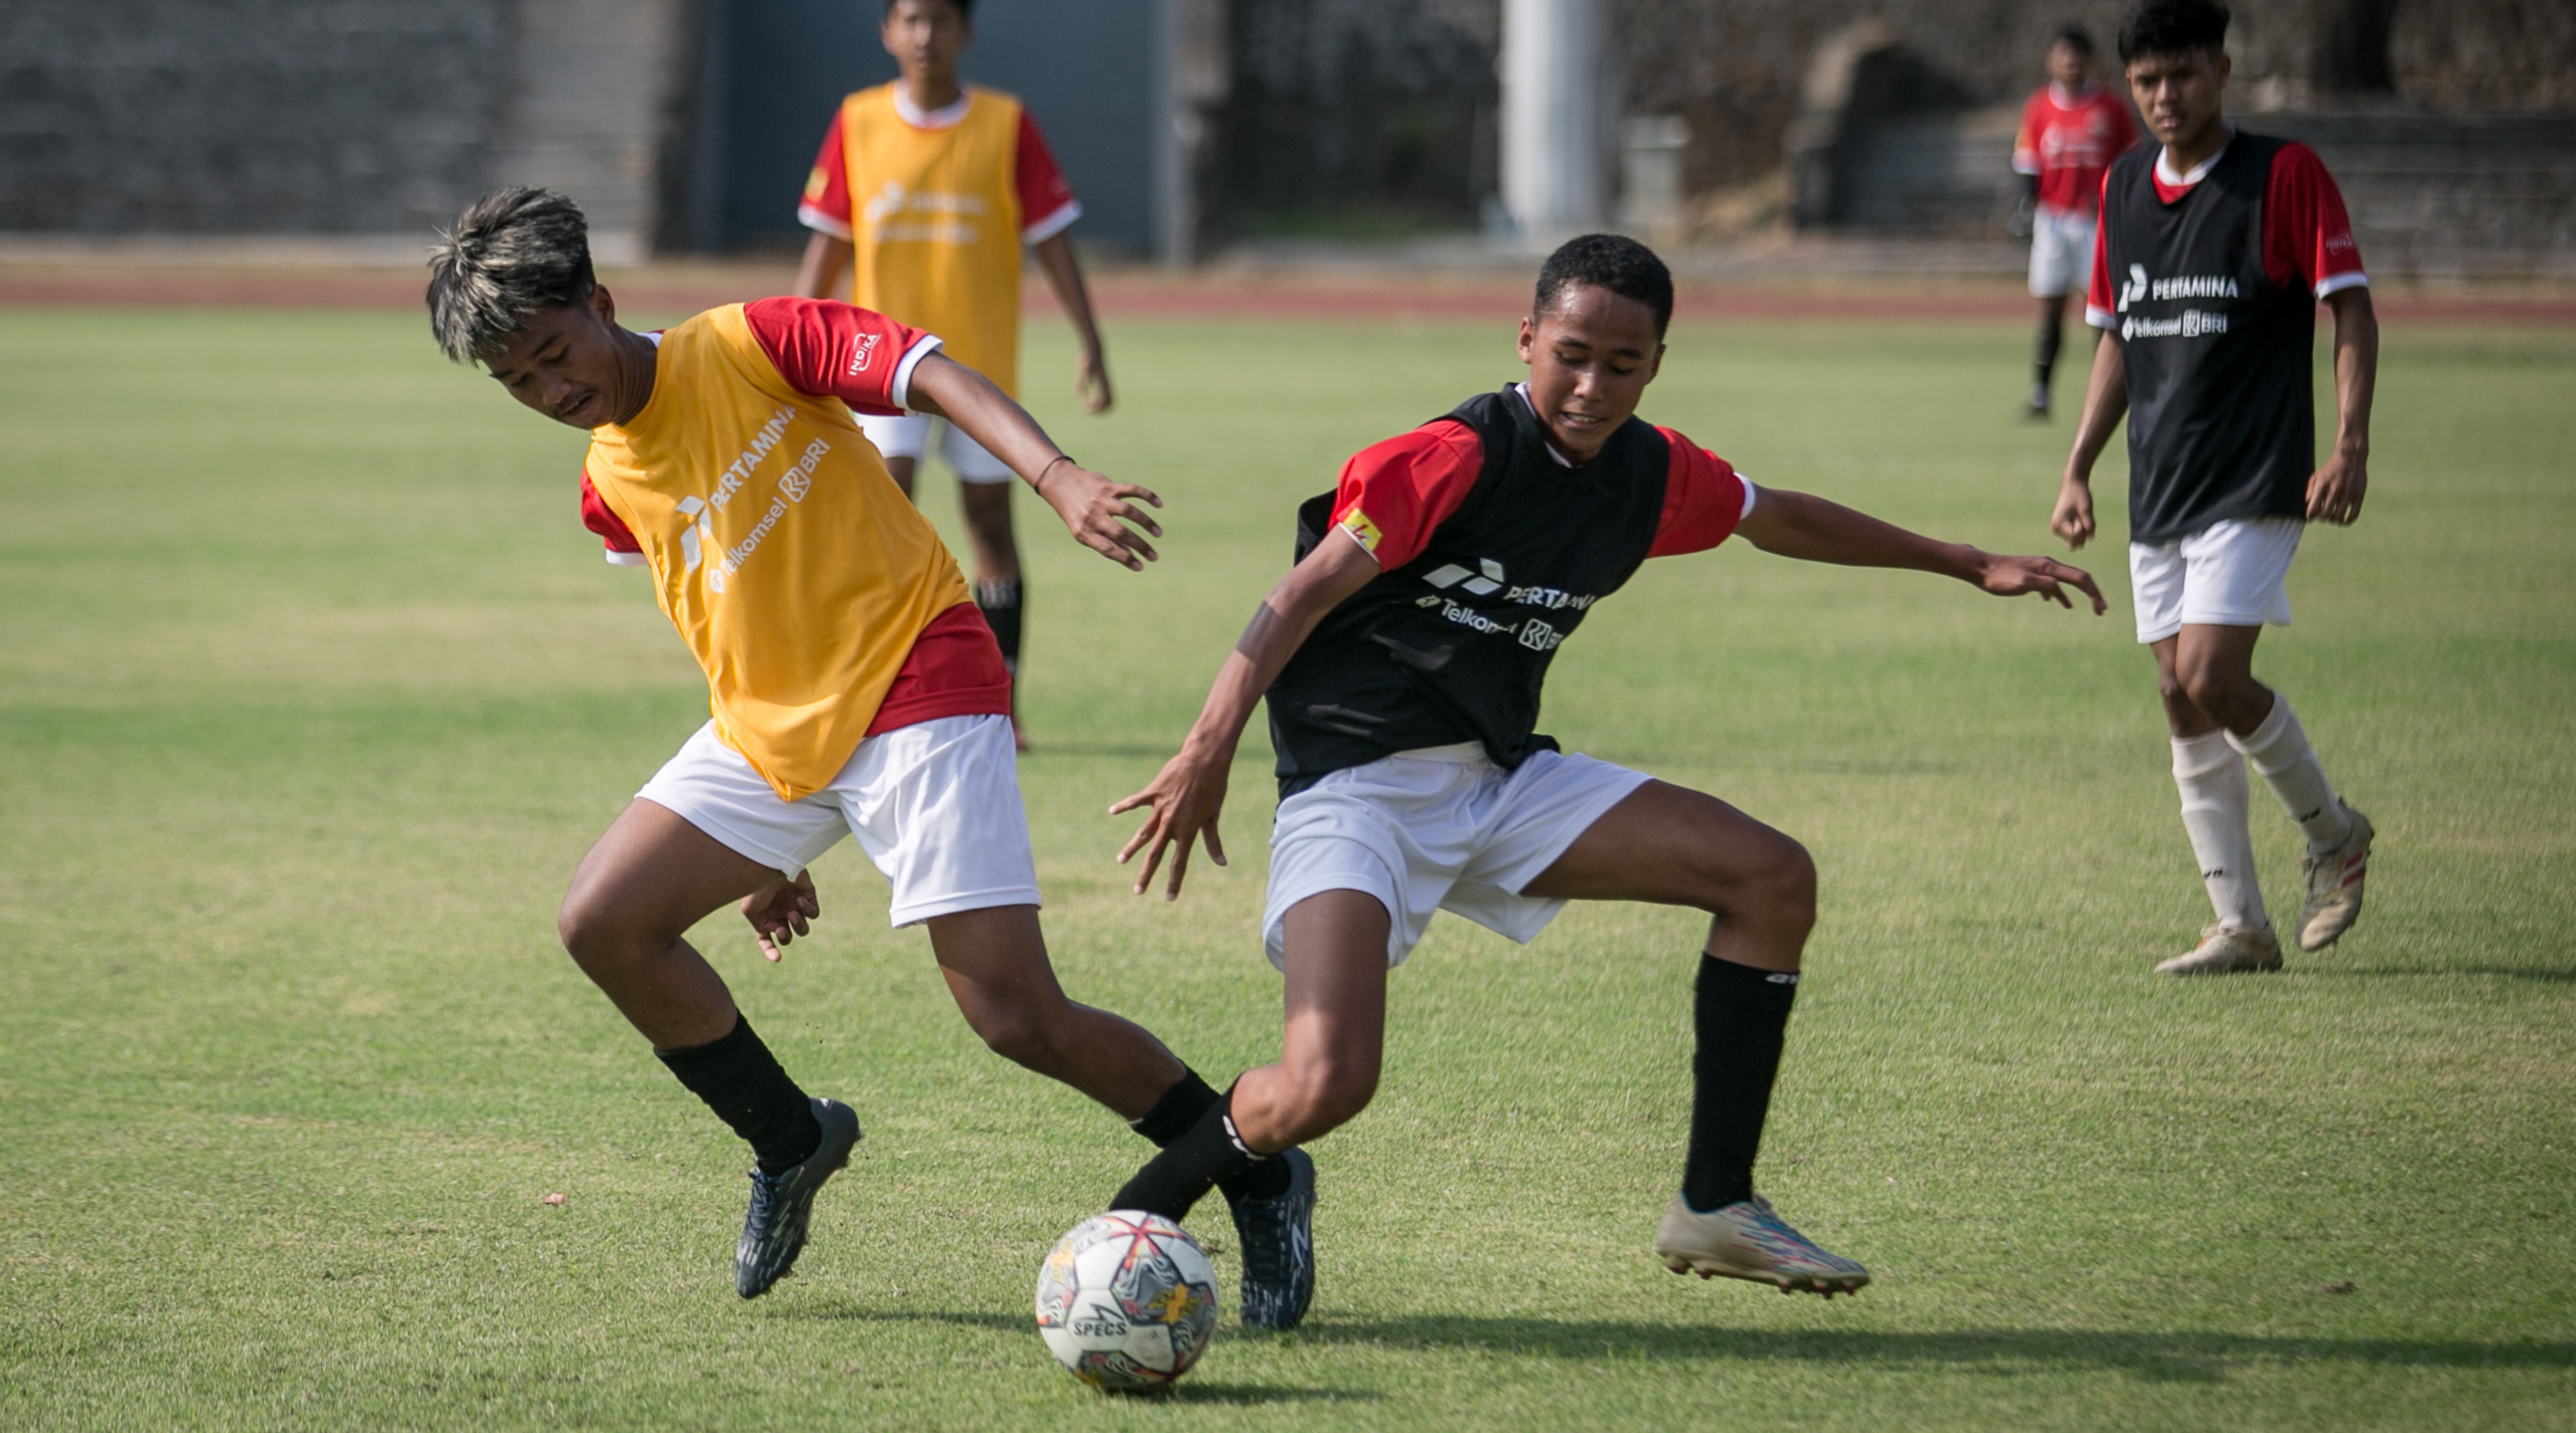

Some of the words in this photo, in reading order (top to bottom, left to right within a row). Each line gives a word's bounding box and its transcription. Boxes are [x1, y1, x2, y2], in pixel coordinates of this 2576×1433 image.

[2152, 275, 2238, 301] PERTAMINA
[2134, 314, 2182, 337] Telkomsel
[2201, 312, 2227, 333] BRI
[848, 334, 877, 376] INDIKA
[720, 496, 789, 577] Telkomsel
[799, 437, 831, 474] BRI
[1074, 1322, 1127, 1337] SPECS
